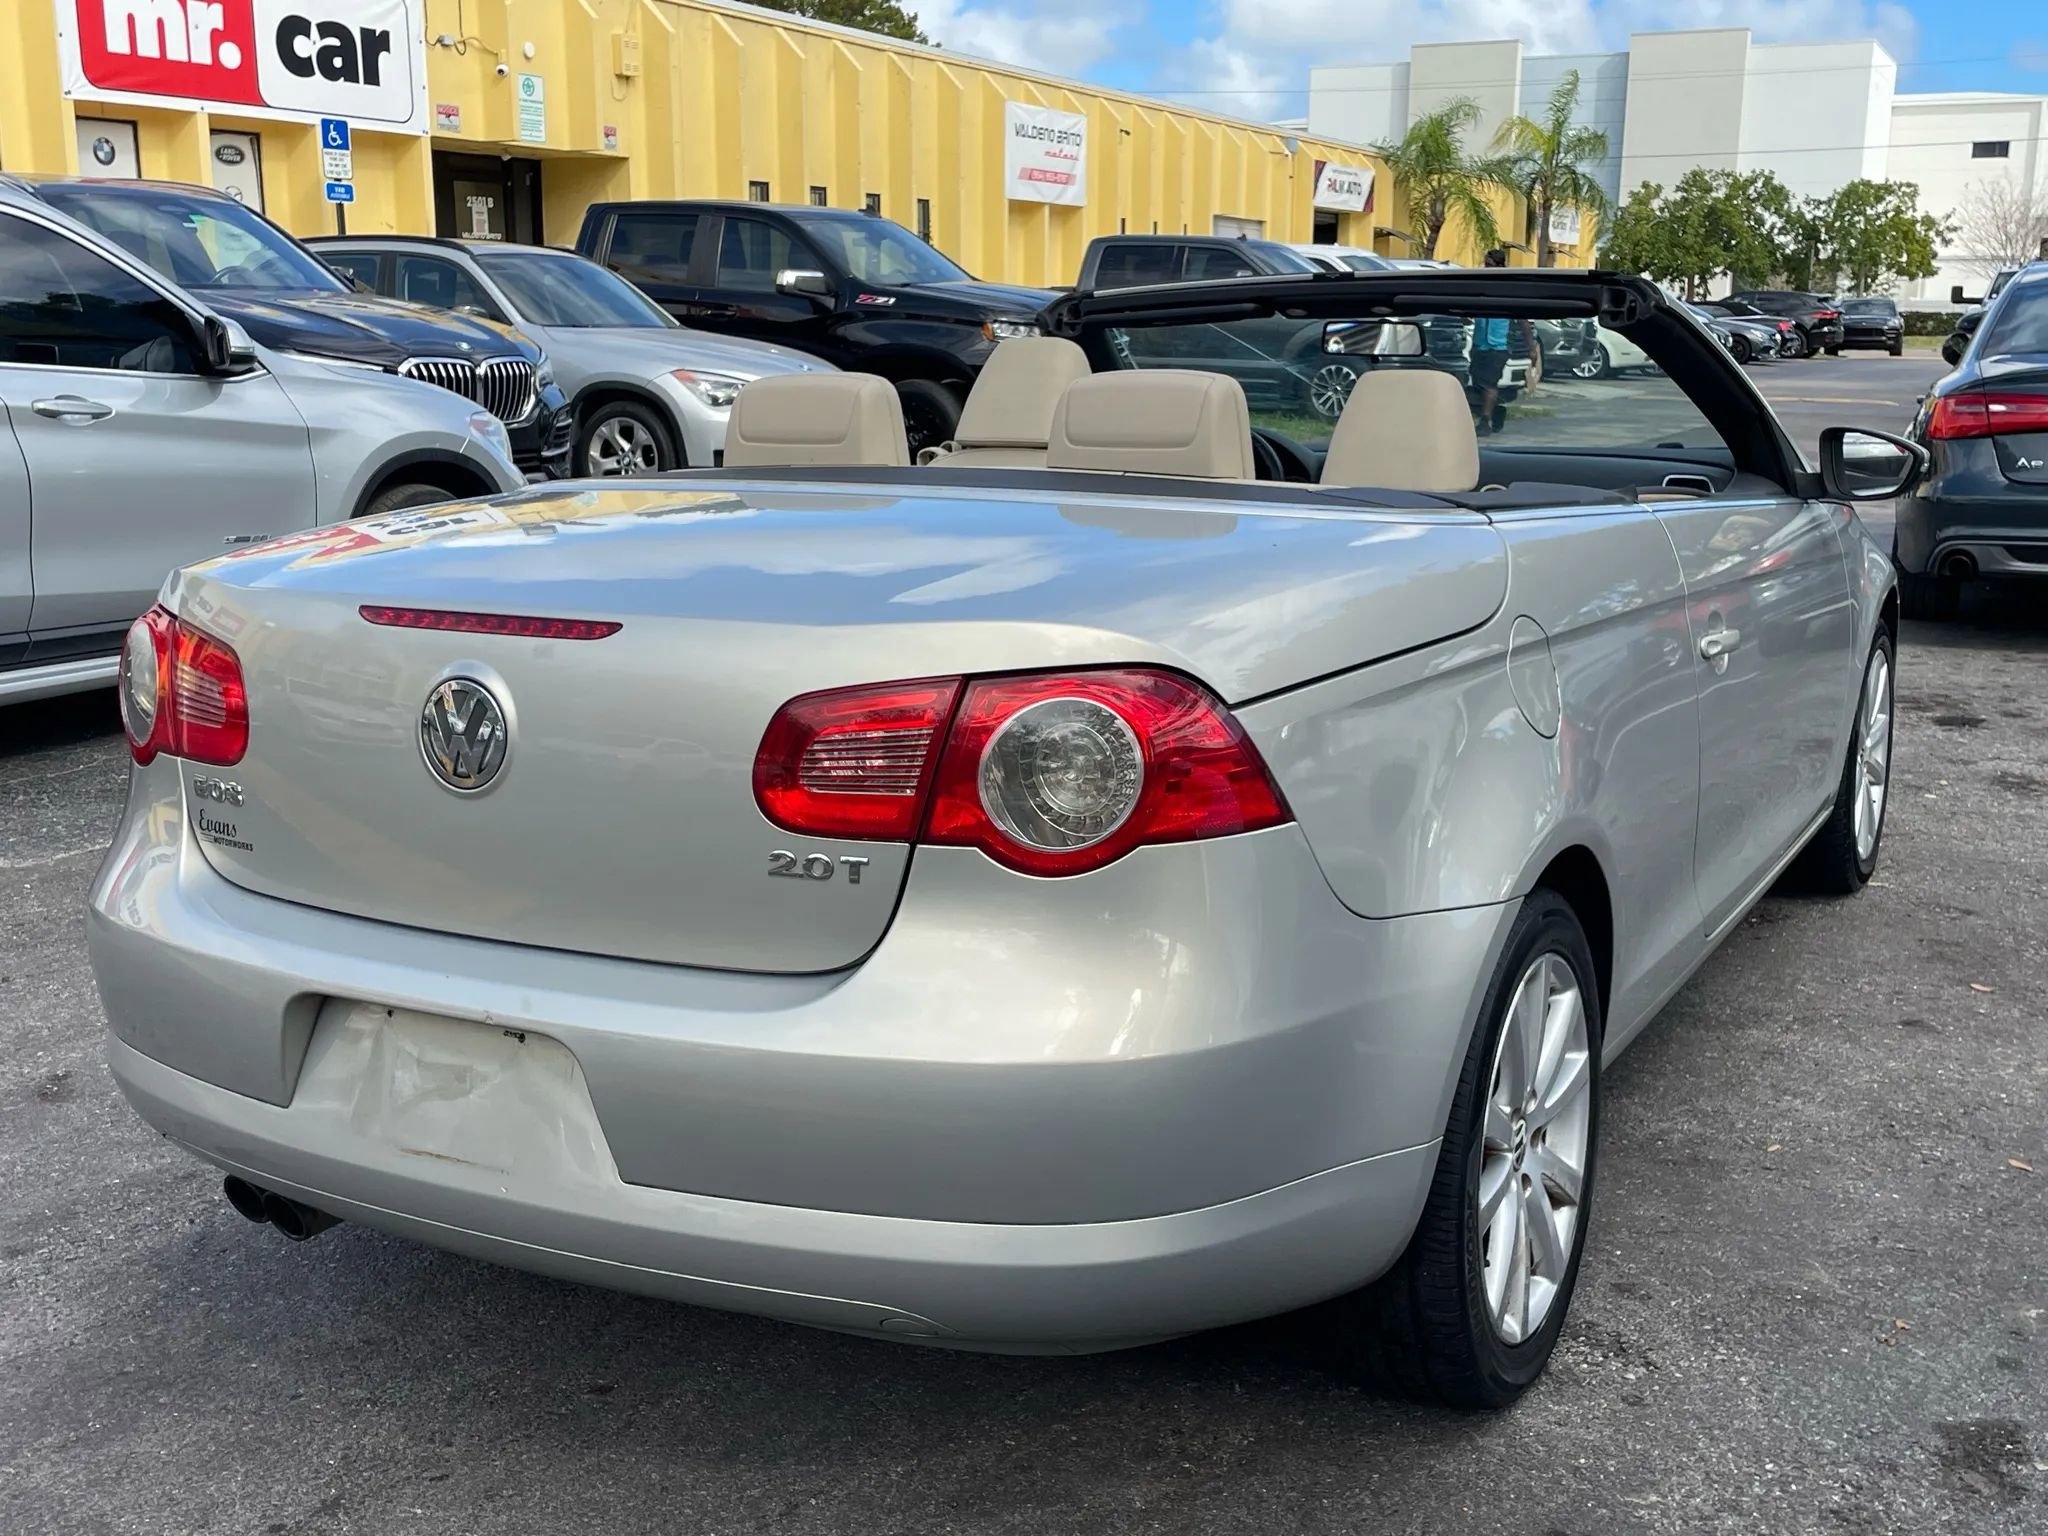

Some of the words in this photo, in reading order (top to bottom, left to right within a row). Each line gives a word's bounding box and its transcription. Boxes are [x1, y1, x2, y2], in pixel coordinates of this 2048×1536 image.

[102, 0, 242, 70] mr.
[276, 14, 390, 87] car
[199, 808, 237, 838] Evans
[213, 836, 254, 852] MOTORWORKS
